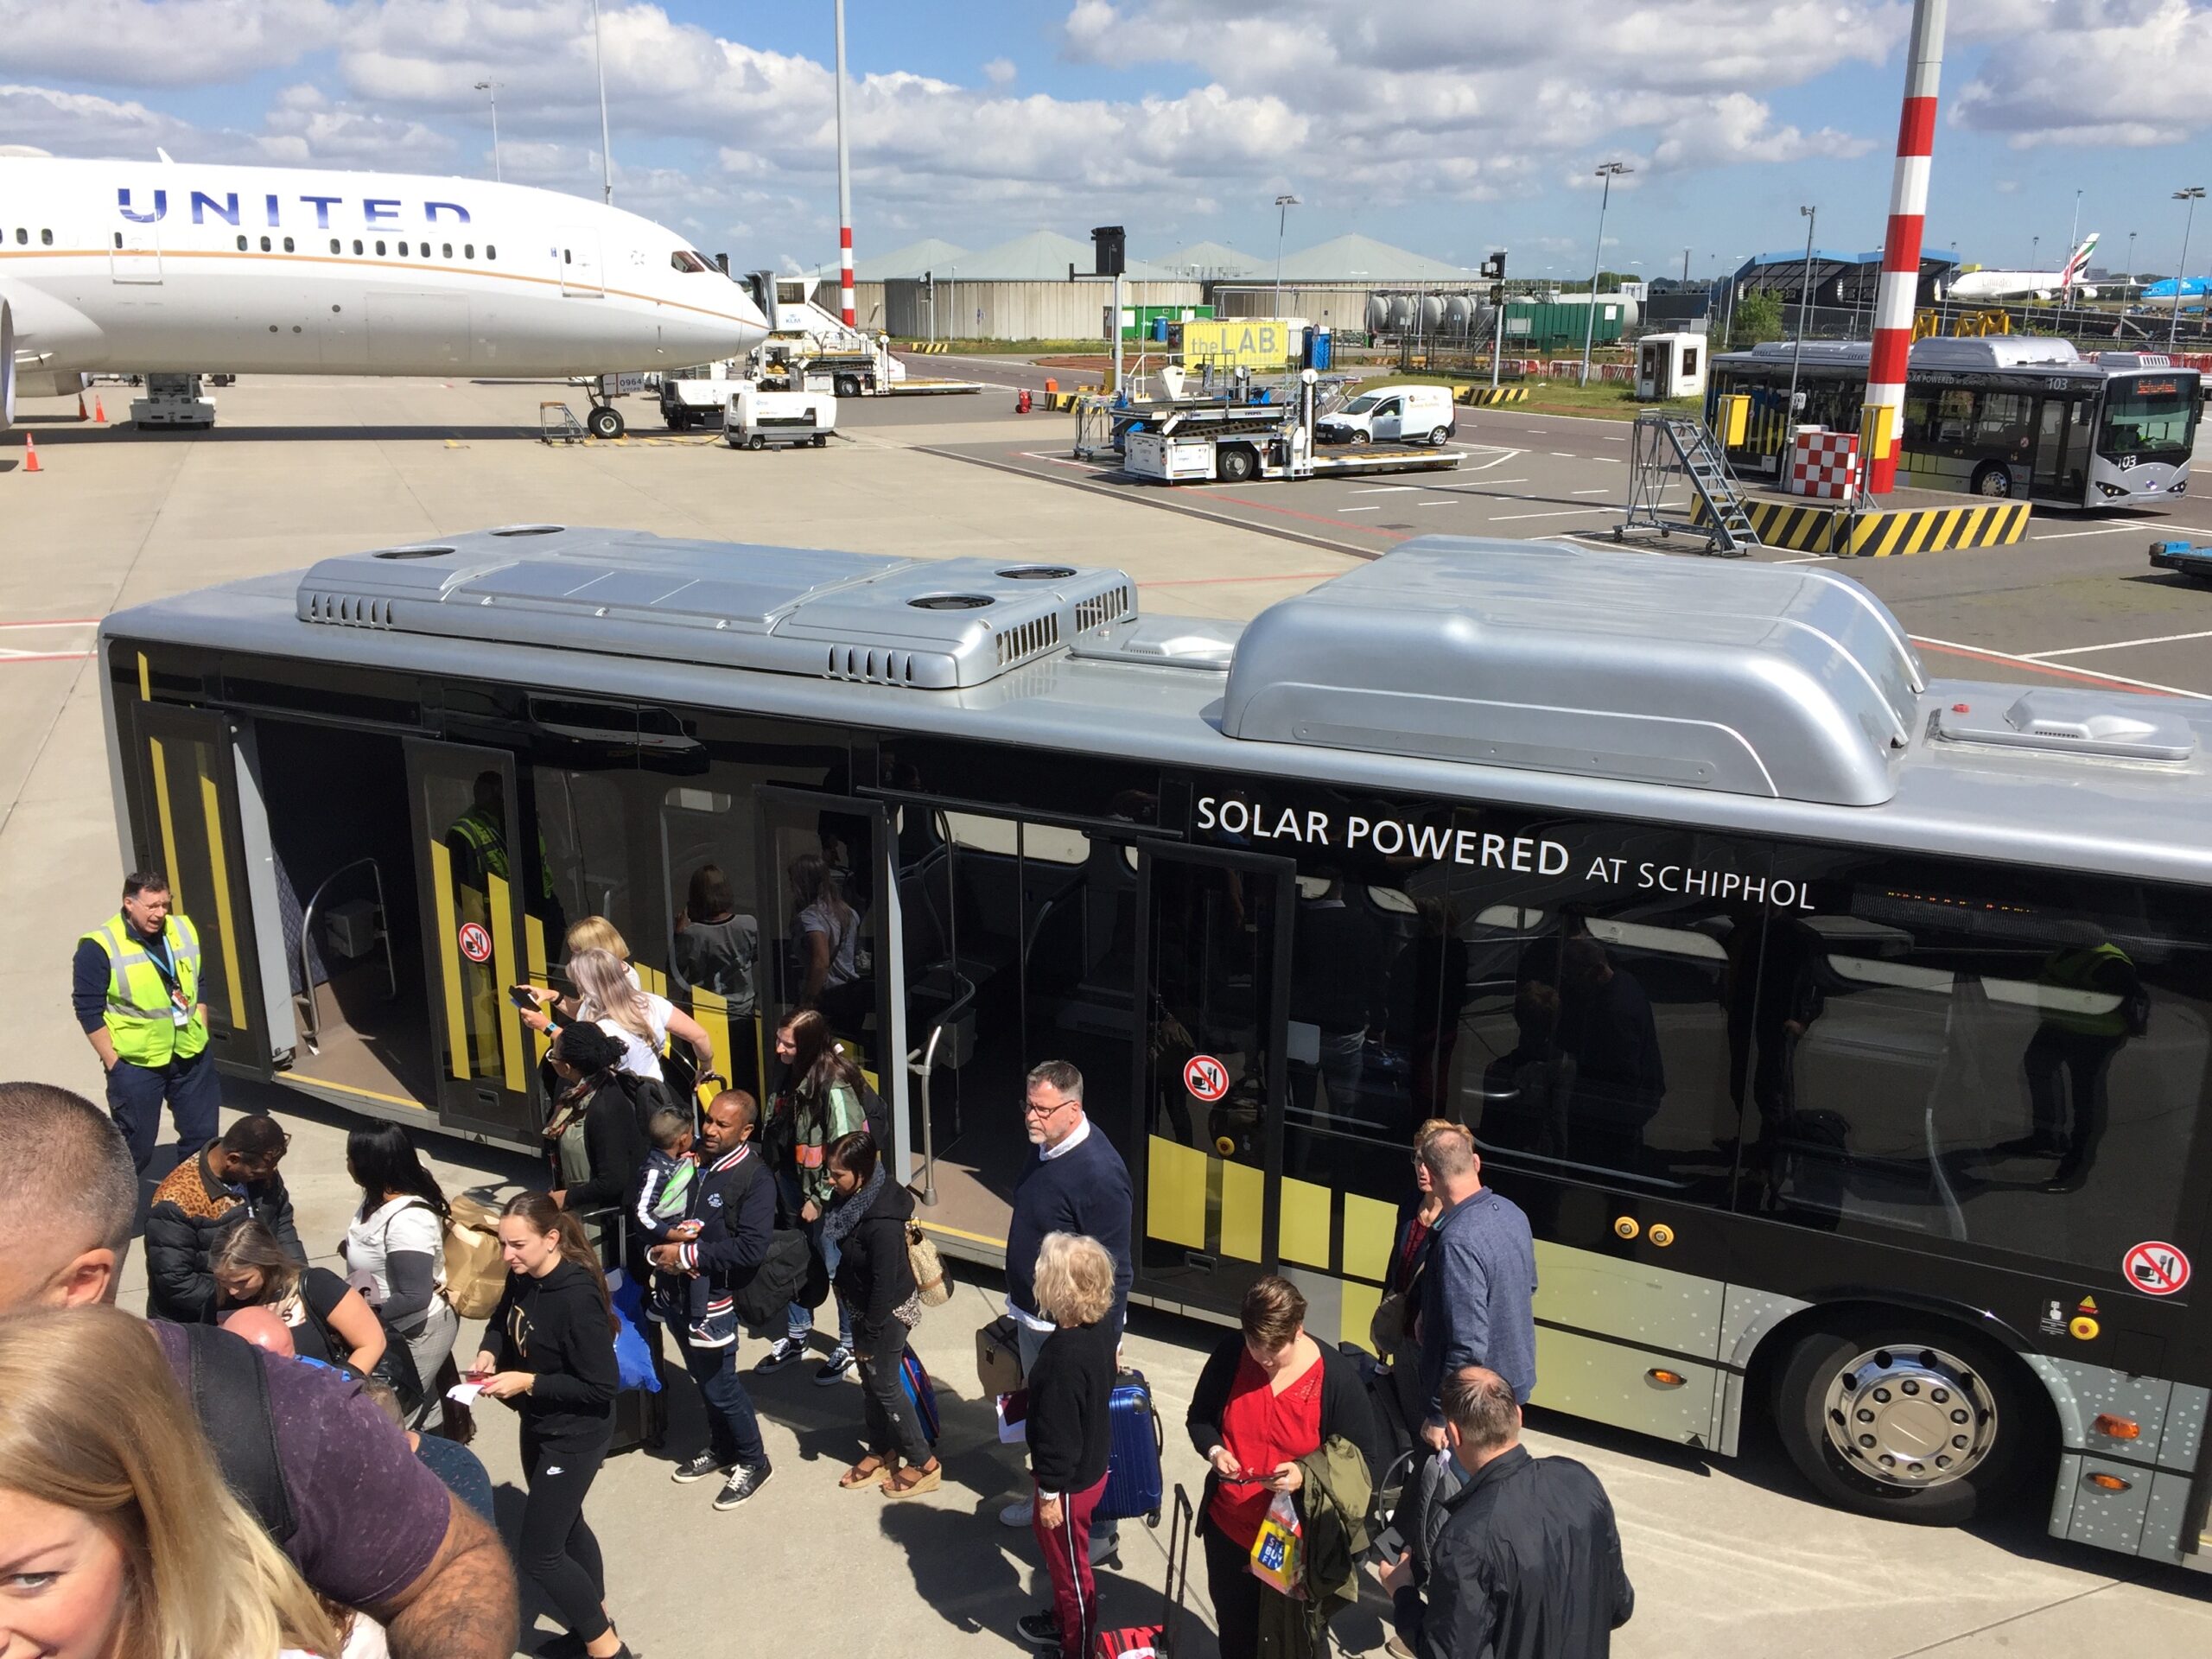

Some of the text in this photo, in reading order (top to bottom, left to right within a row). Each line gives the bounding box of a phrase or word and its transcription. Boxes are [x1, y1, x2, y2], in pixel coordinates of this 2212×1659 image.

[118, 188, 471, 233] UNITED
[2047, 378, 2068, 390] 103
[2118, 455, 2137, 468] 103
[1197, 797, 1815, 910] SOLAR POWERED AT SCHIPHOL
[1265, 1546, 1283, 1562] BUY
